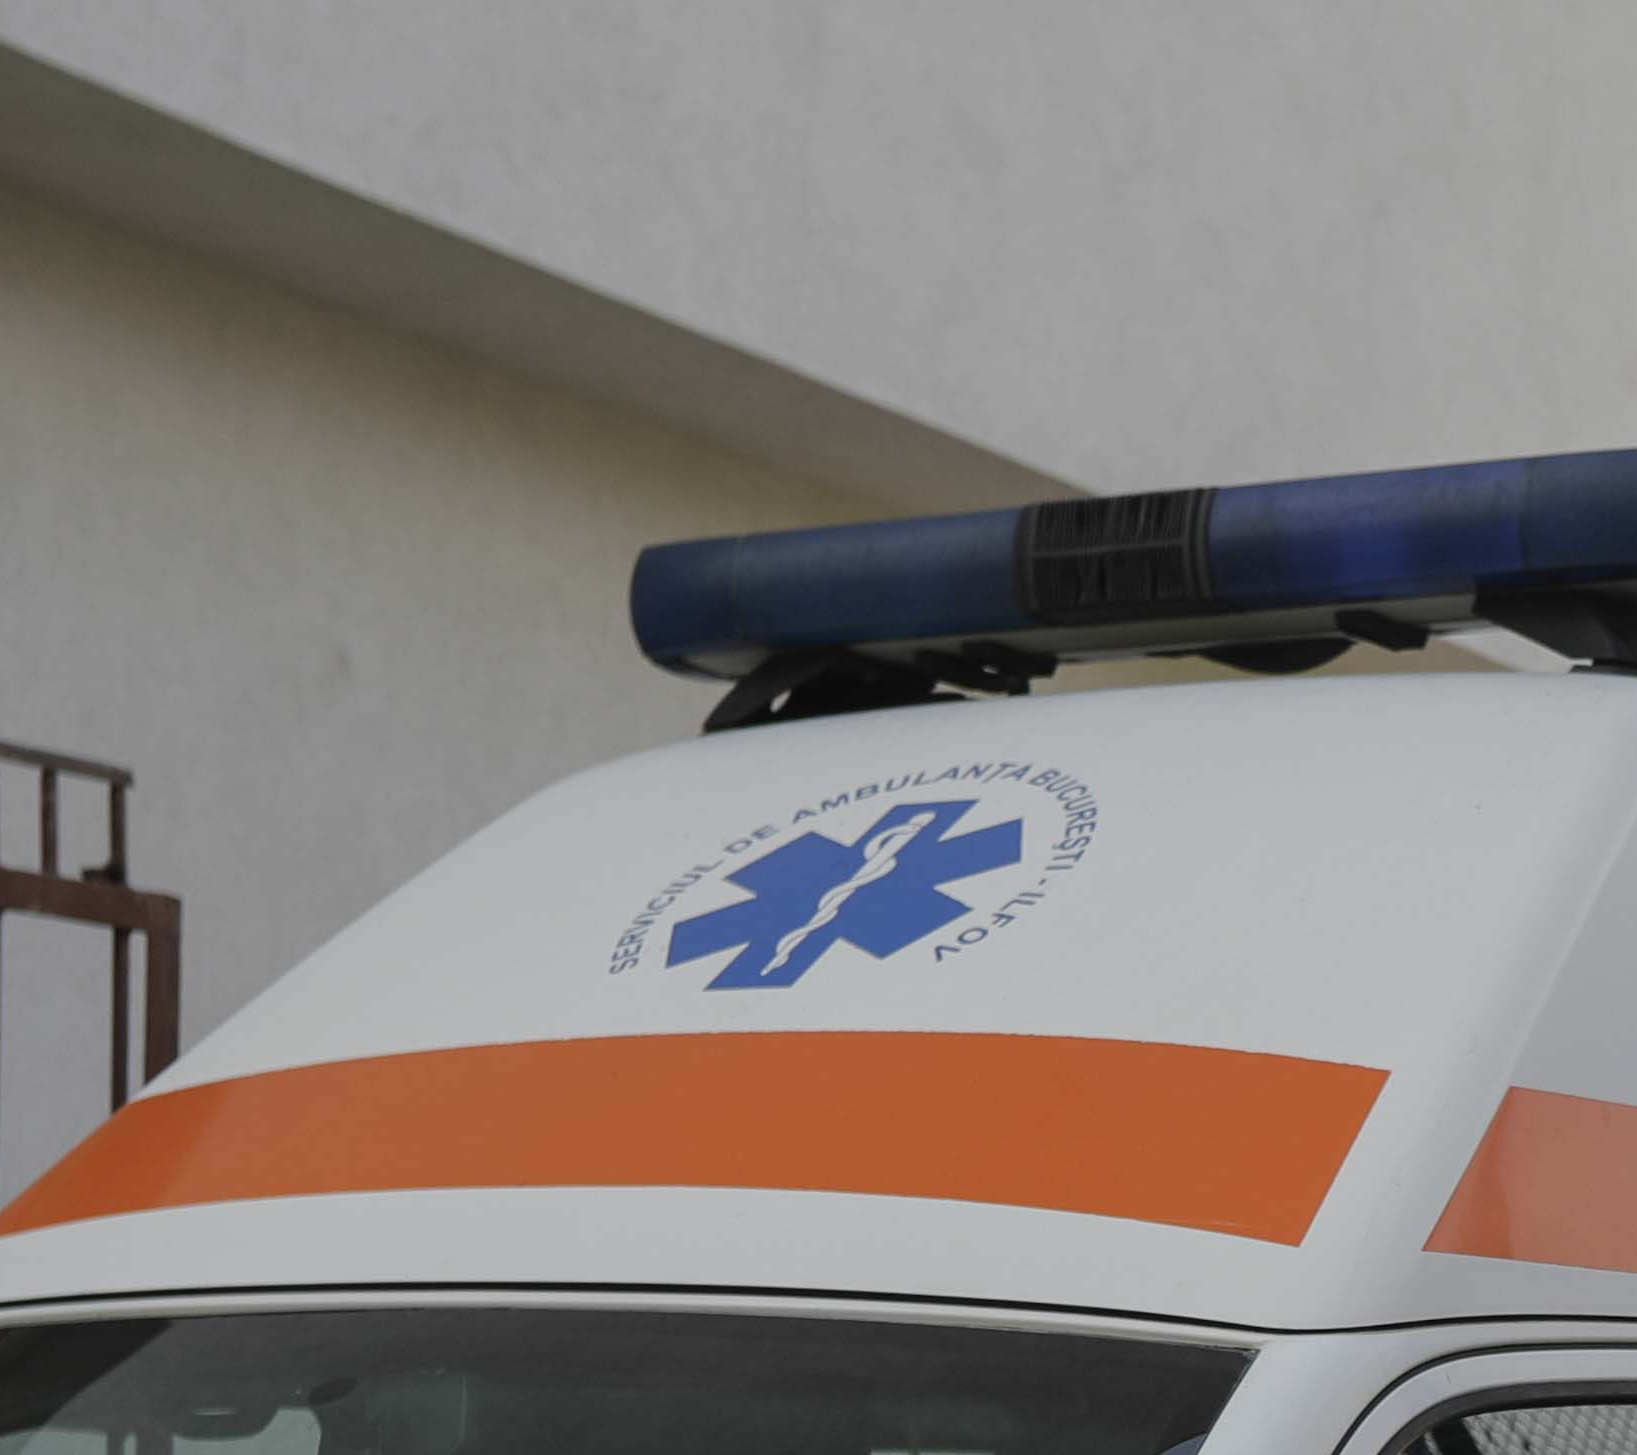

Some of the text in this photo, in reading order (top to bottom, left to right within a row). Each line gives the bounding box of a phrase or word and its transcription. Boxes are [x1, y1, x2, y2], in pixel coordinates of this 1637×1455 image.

[609, 860, 724, 975] SERVICIUL
[723, 824, 780, 854] DE
[934, 891, 1045, 962] ILFOV
